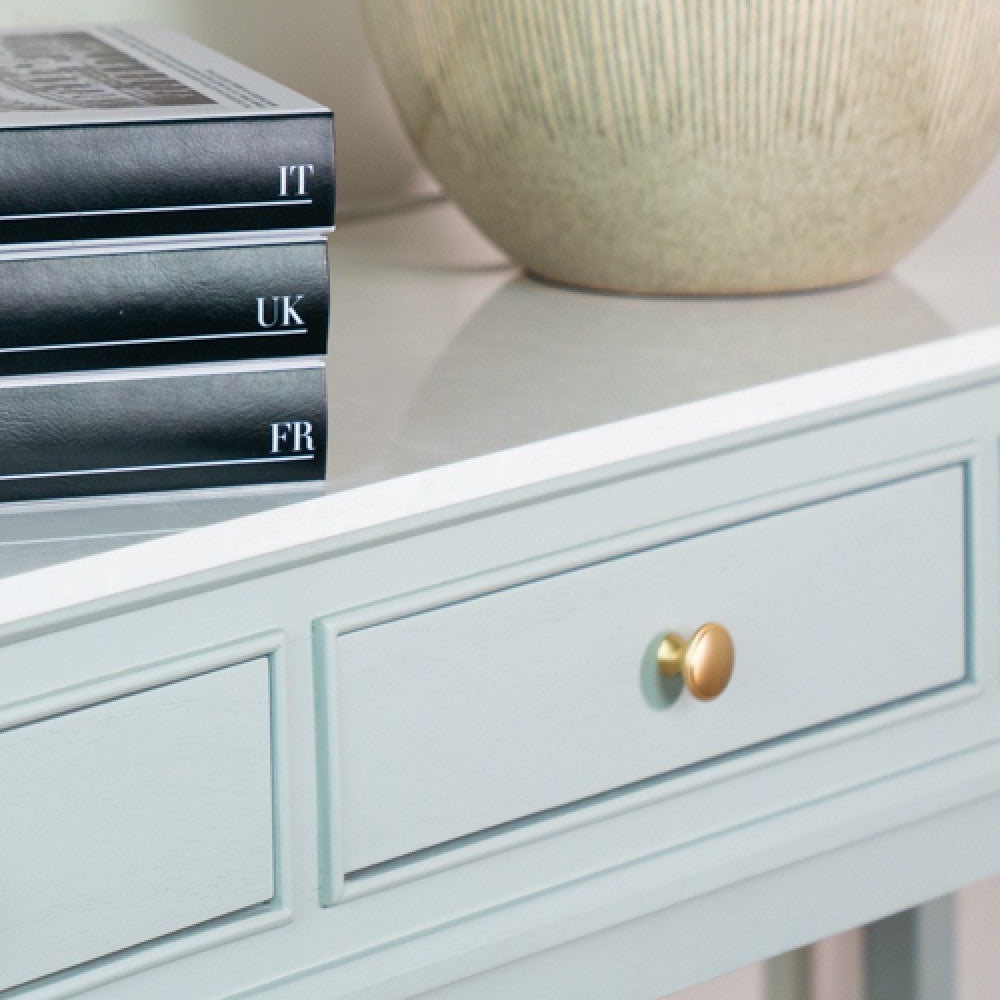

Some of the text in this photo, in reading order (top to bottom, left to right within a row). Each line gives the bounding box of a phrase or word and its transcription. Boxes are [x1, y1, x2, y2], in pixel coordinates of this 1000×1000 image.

[277, 163, 315, 197] IT
[255, 294, 306, 328] UK
[269, 421, 316, 454] FR
